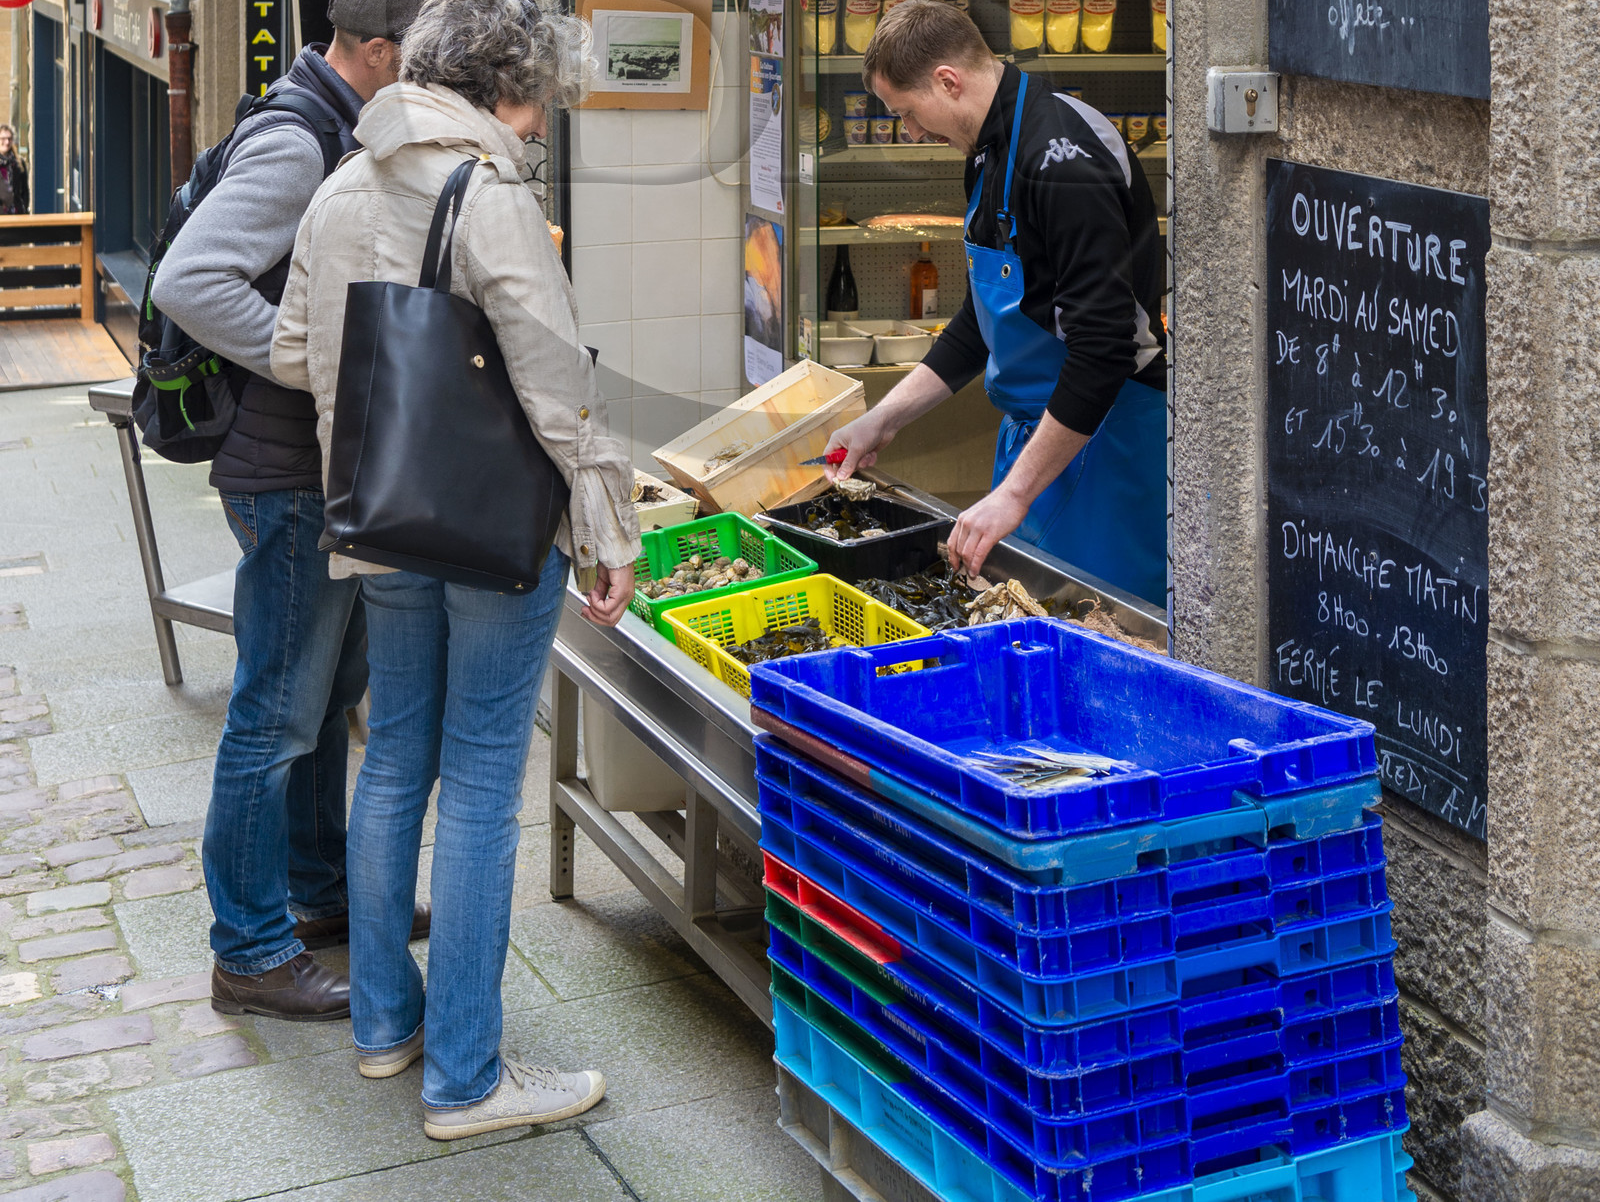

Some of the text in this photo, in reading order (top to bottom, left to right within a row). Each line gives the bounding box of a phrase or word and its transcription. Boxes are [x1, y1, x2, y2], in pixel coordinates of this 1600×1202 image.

[1292, 192, 1467, 285] OUVERTURE
[1354, 288, 1379, 332] AU
[1276, 330, 1300, 365] DE
[1285, 407, 1308, 435] ET
[1355, 676, 1383, 709] LE
